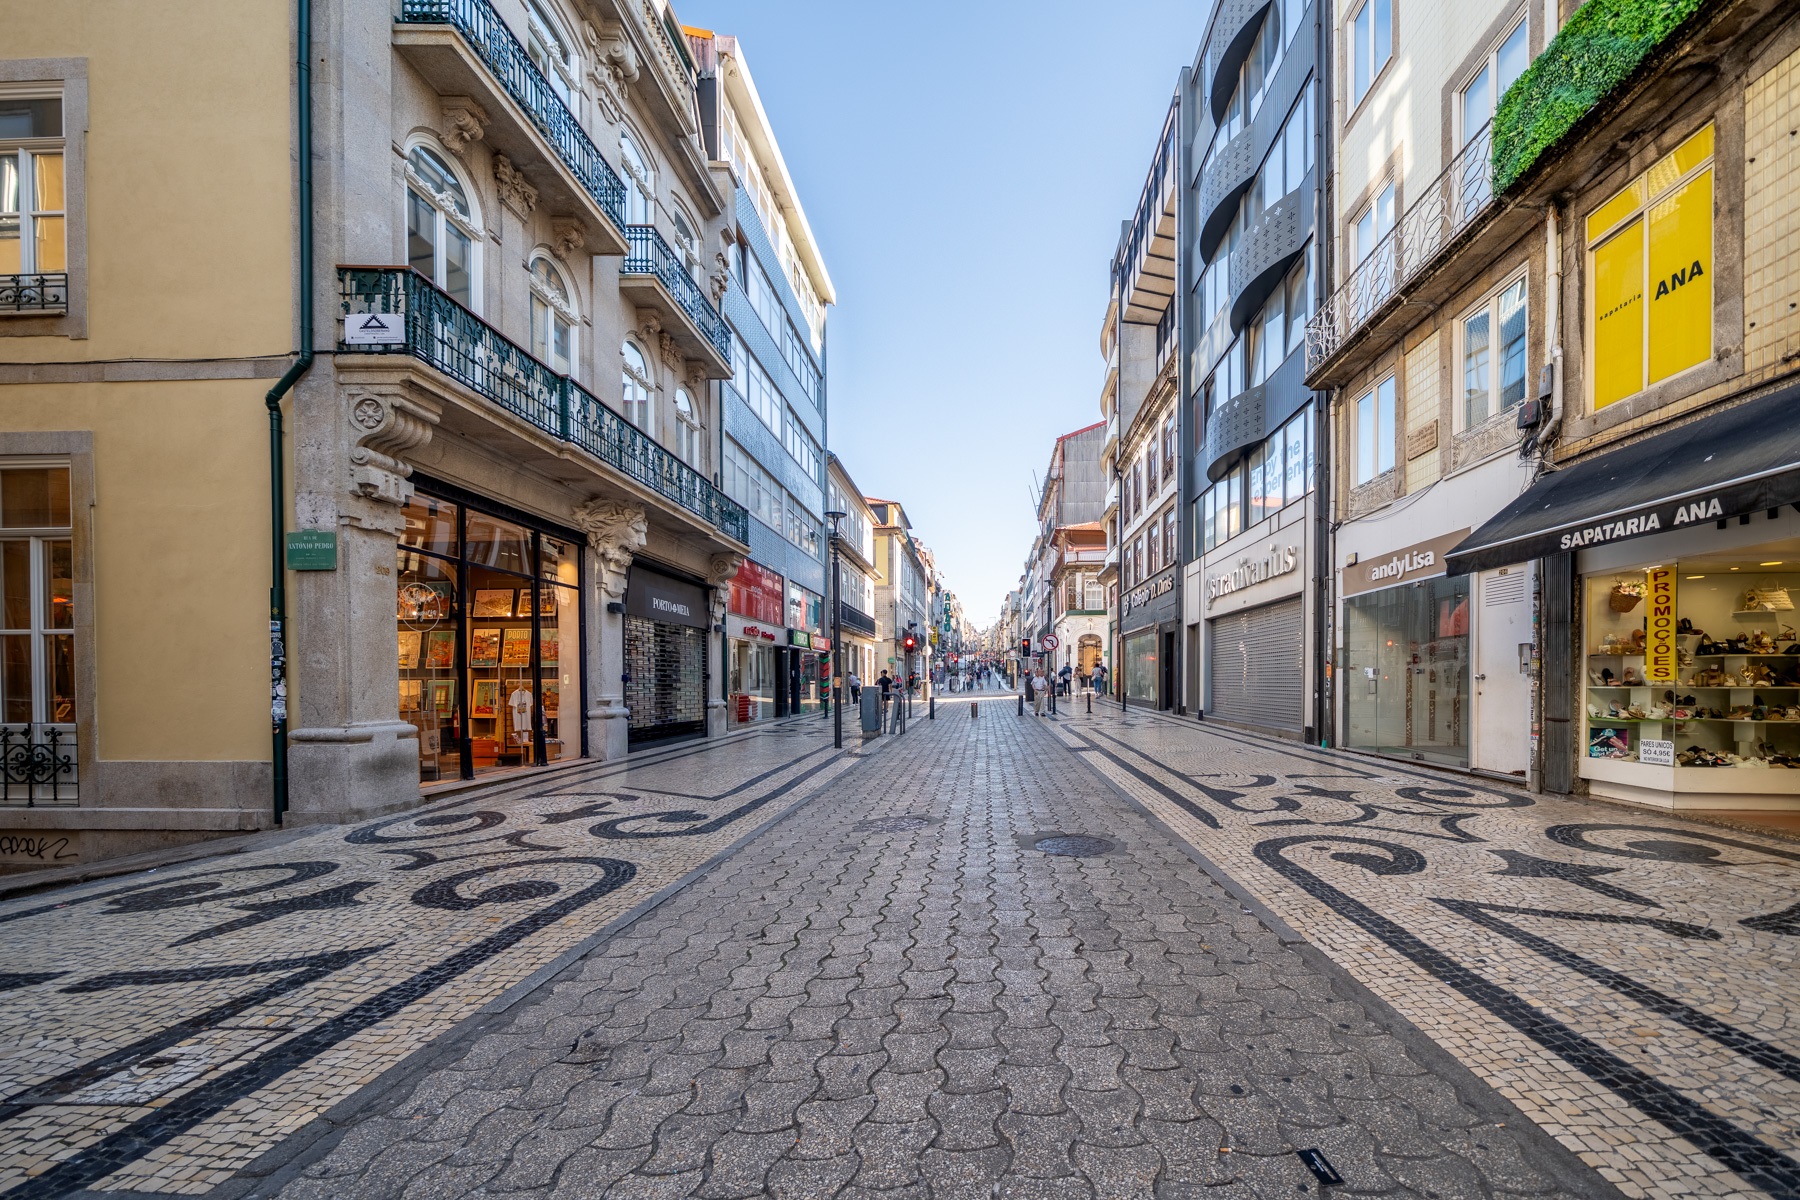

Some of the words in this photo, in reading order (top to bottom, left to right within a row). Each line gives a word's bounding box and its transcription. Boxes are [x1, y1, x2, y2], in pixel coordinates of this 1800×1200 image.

[1599, 294, 1642, 321] sapataria
[1654, 260, 1704, 301] ANA
[1560, 513, 1660, 550] SAPATARIA
[1673, 498, 1723, 525] ANA
[653, 597, 671, 612] PORTO
[1653, 570, 1671, 678] PROMOÇÕES
[508, 630, 528, 639] PORTO
[1640, 740, 1655, 748] PARES
[1653, 749, 1671, 757] 4,95€
